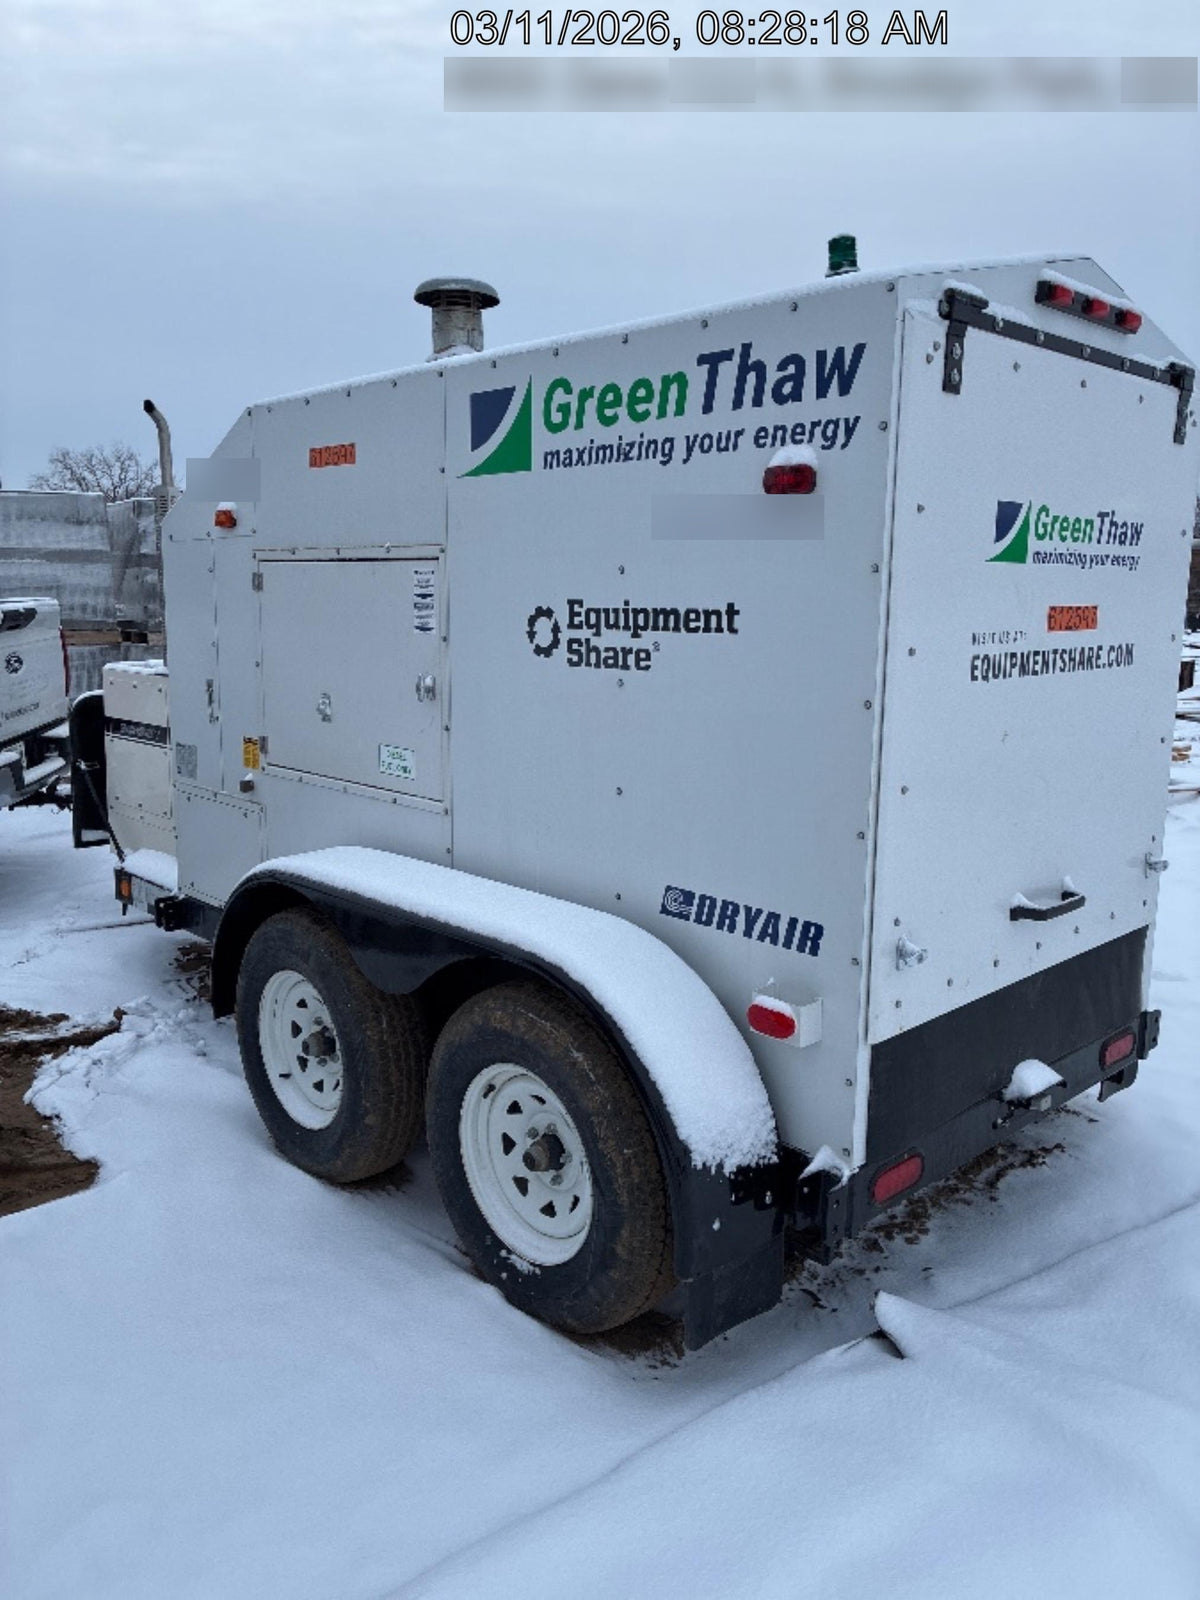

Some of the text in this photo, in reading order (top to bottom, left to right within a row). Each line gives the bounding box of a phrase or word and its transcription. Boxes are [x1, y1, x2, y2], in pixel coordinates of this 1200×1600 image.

[542, 415, 861, 471] maximizing your energy
[566, 599, 740, 639] Equipment
[970, 643, 1135, 683] EQUIPMENTSHARE.COM
[693, 893, 825, 957] DRYAIR
